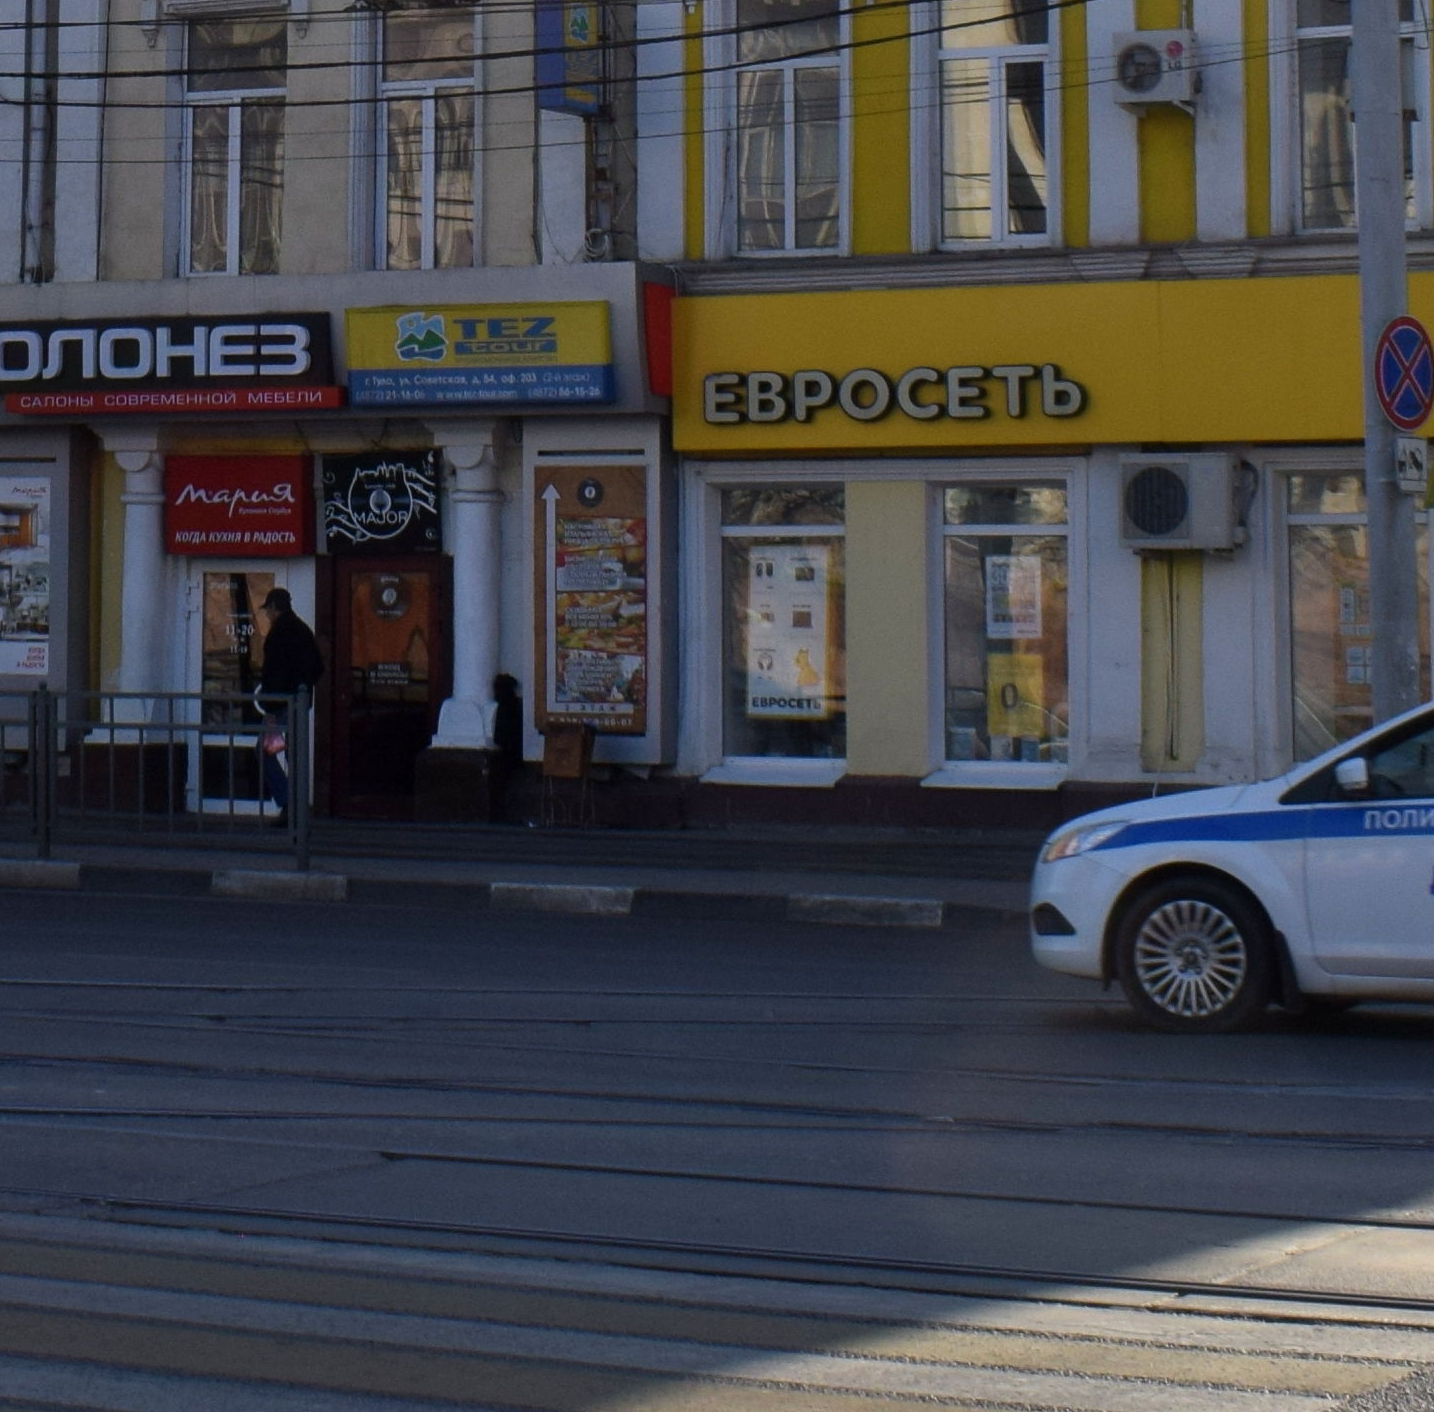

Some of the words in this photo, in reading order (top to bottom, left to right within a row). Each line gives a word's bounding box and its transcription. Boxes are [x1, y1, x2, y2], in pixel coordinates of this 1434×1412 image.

[452, 315, 557, 340] TEZ
[19, 393, 95, 409] САЛОНЫ
[104, 389, 238, 407] СОВРЕМЕННОЙ
[247, 387, 324, 405] МЕБЕЛИ
[703, 362, 1088, 424] ЕВРОСЕТЬ
[174, 481, 297, 519] Мария
[353, 510, 409, 526] MAJOR
[175, 531, 207, 545] КОГДА
[209, 531, 241, 544] КУХНЯ
[244, 531, 251, 543] В
[253, 531, 297, 545] РАДОСТЬ
[752, 695, 821, 710] ЕВРОСЕТЬ
